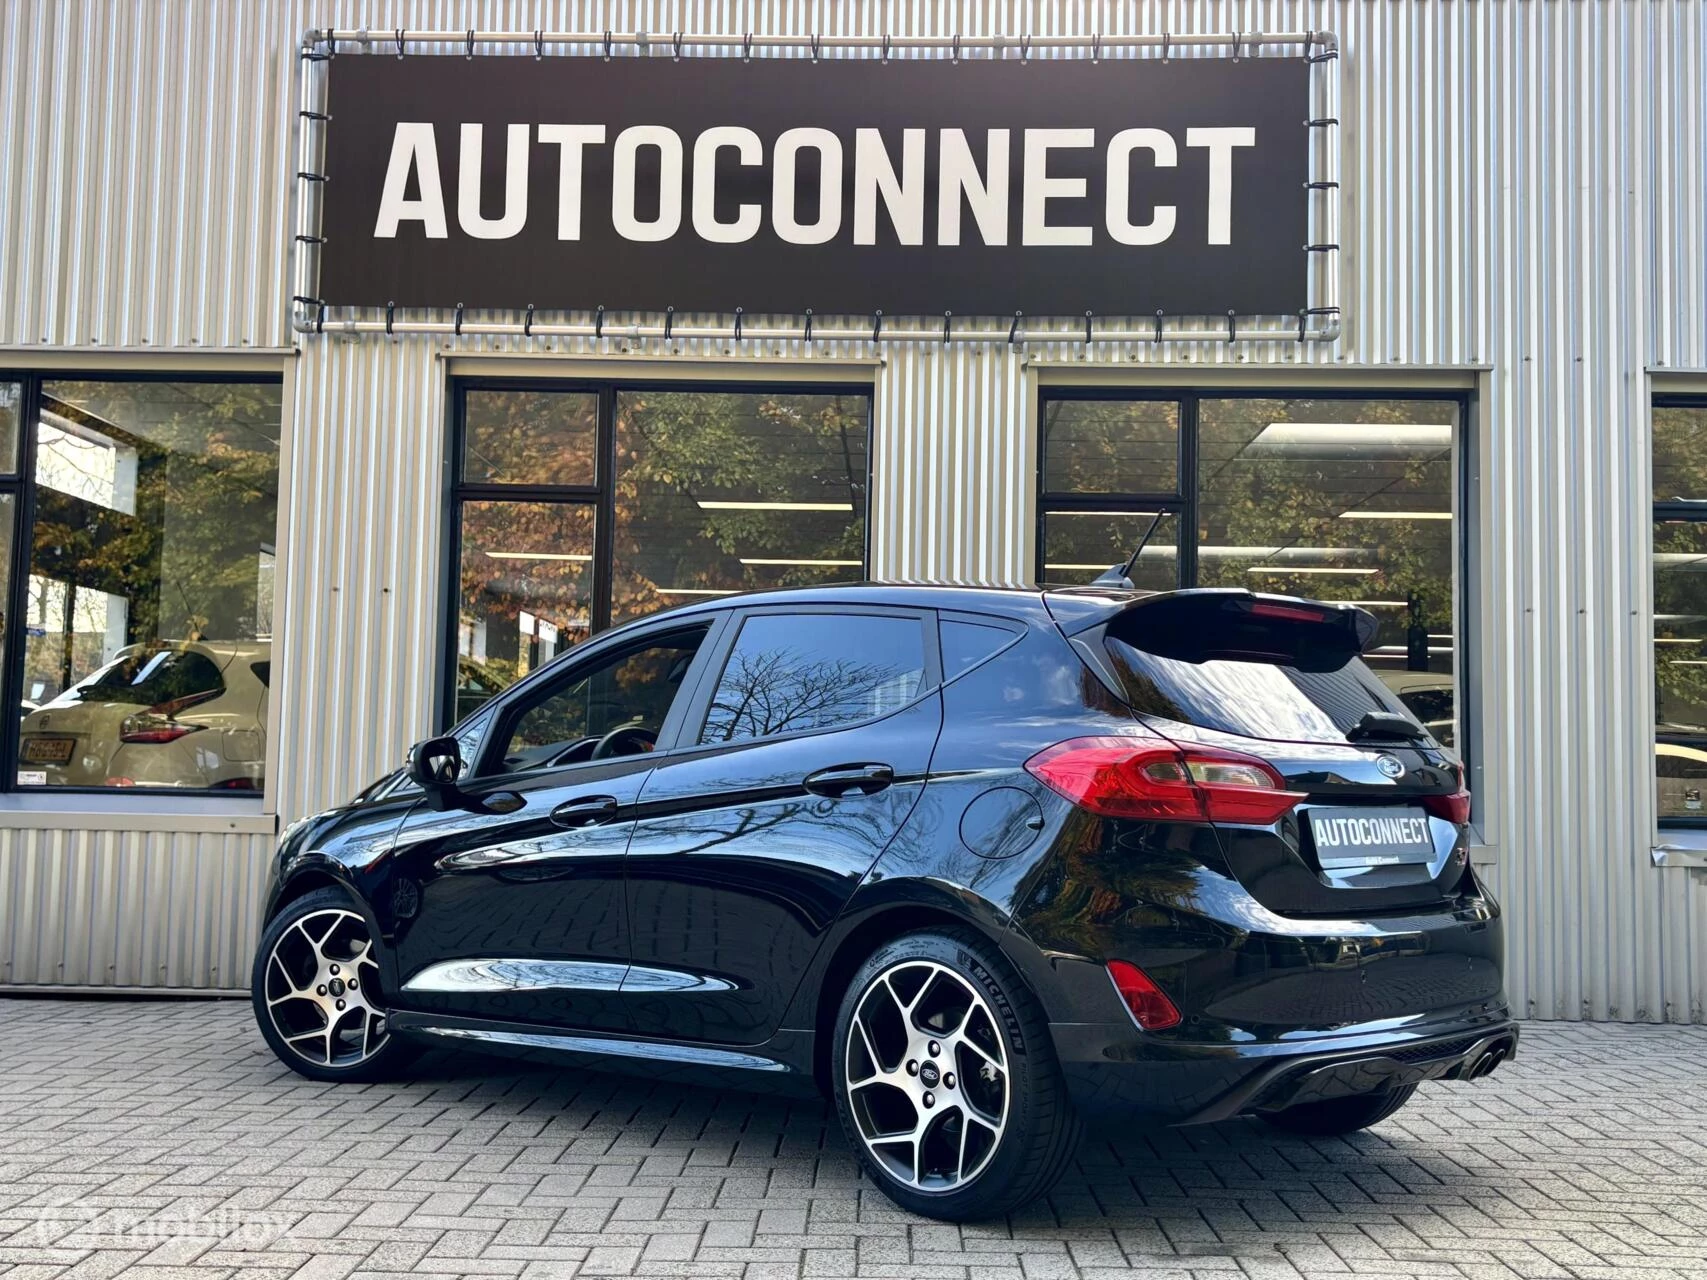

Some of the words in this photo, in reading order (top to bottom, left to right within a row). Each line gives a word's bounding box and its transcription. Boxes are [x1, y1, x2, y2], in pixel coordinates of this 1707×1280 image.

[373, 121, 1257, 247] AUTOCONNECT
[1314, 818, 1429, 847] AUTOCONNECT
[973, 965, 1024, 1050] MICHELIN
